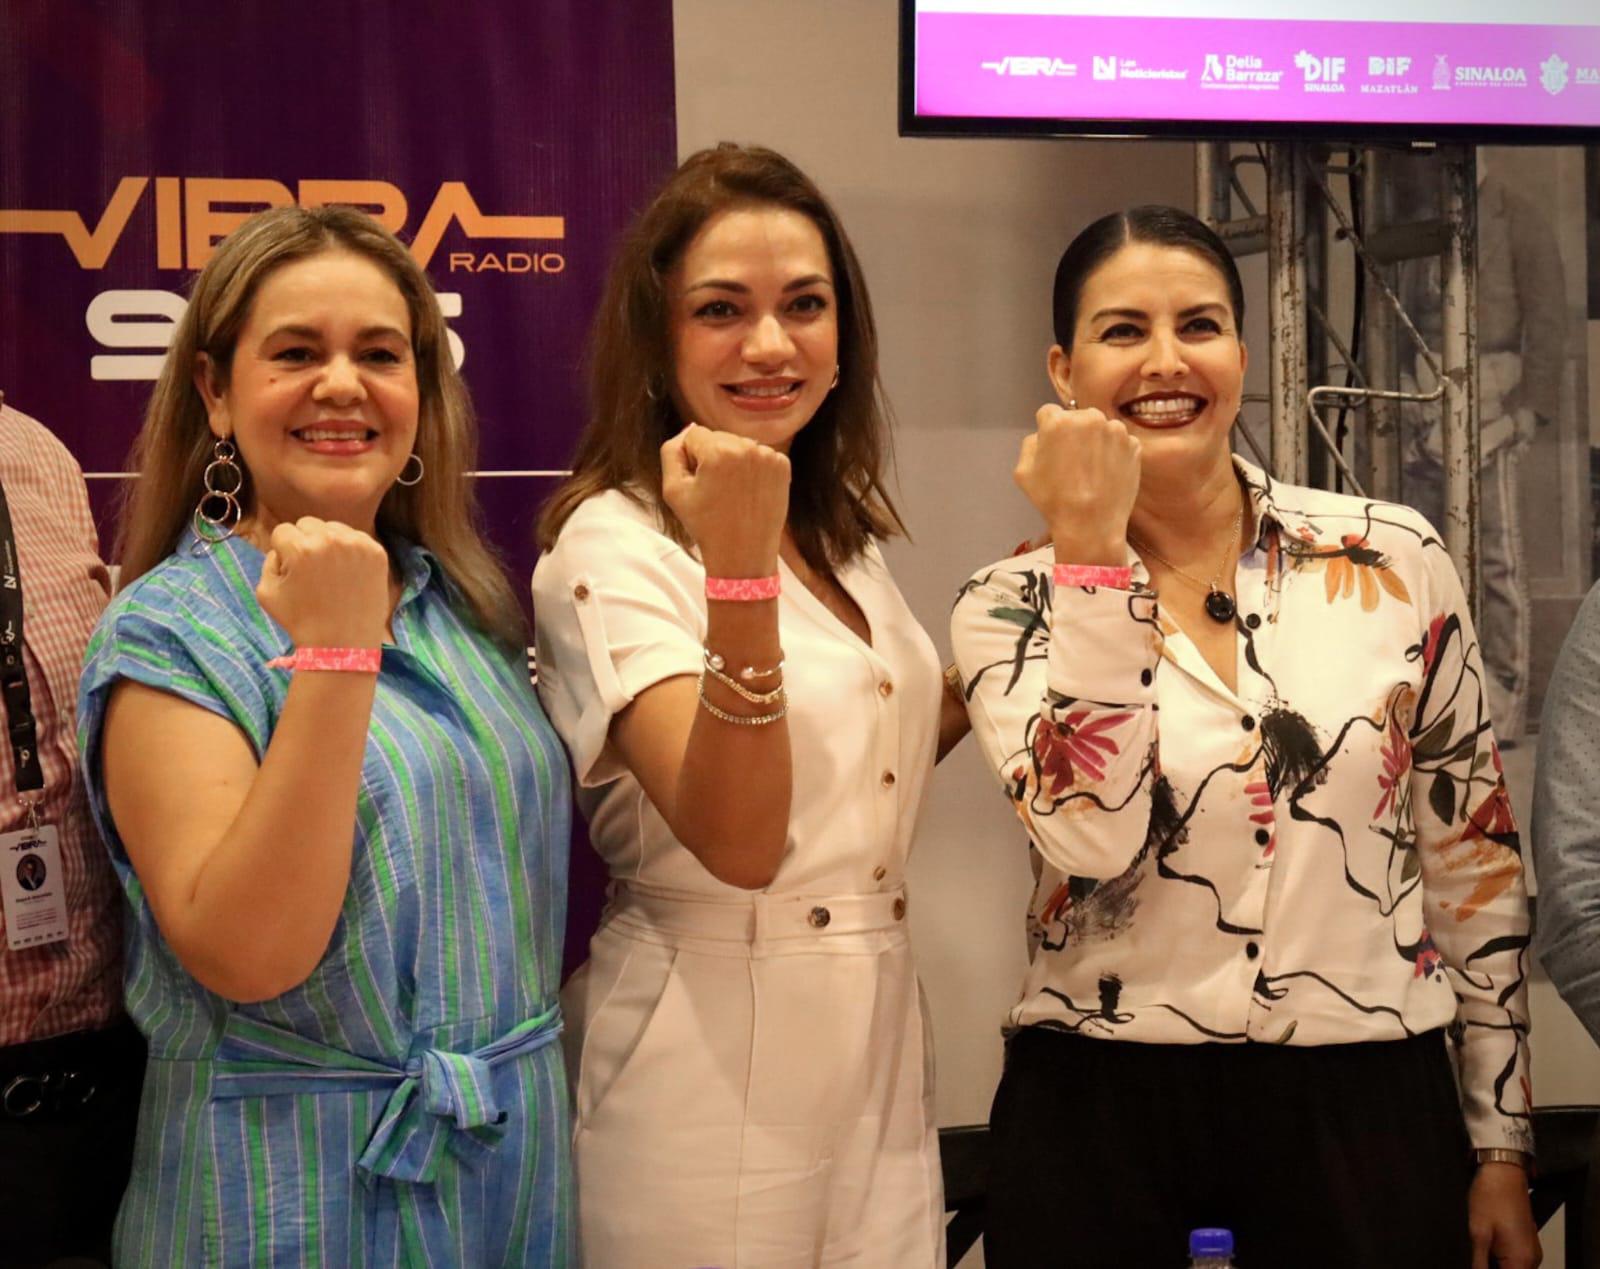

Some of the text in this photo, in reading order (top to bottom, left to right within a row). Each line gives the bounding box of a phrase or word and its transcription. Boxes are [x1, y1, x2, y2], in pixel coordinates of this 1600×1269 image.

[1226, 54, 1262, 69] Delia
[1303, 56, 1346, 82] DIF
[1368, 56, 1412, 76] DIF
[1226, 69, 1280, 82] Barraza
[1455, 66, 1527, 82] SINALOA
[1304, 83, 1345, 93] SINALOA
[450, 252, 565, 274] RADIO
